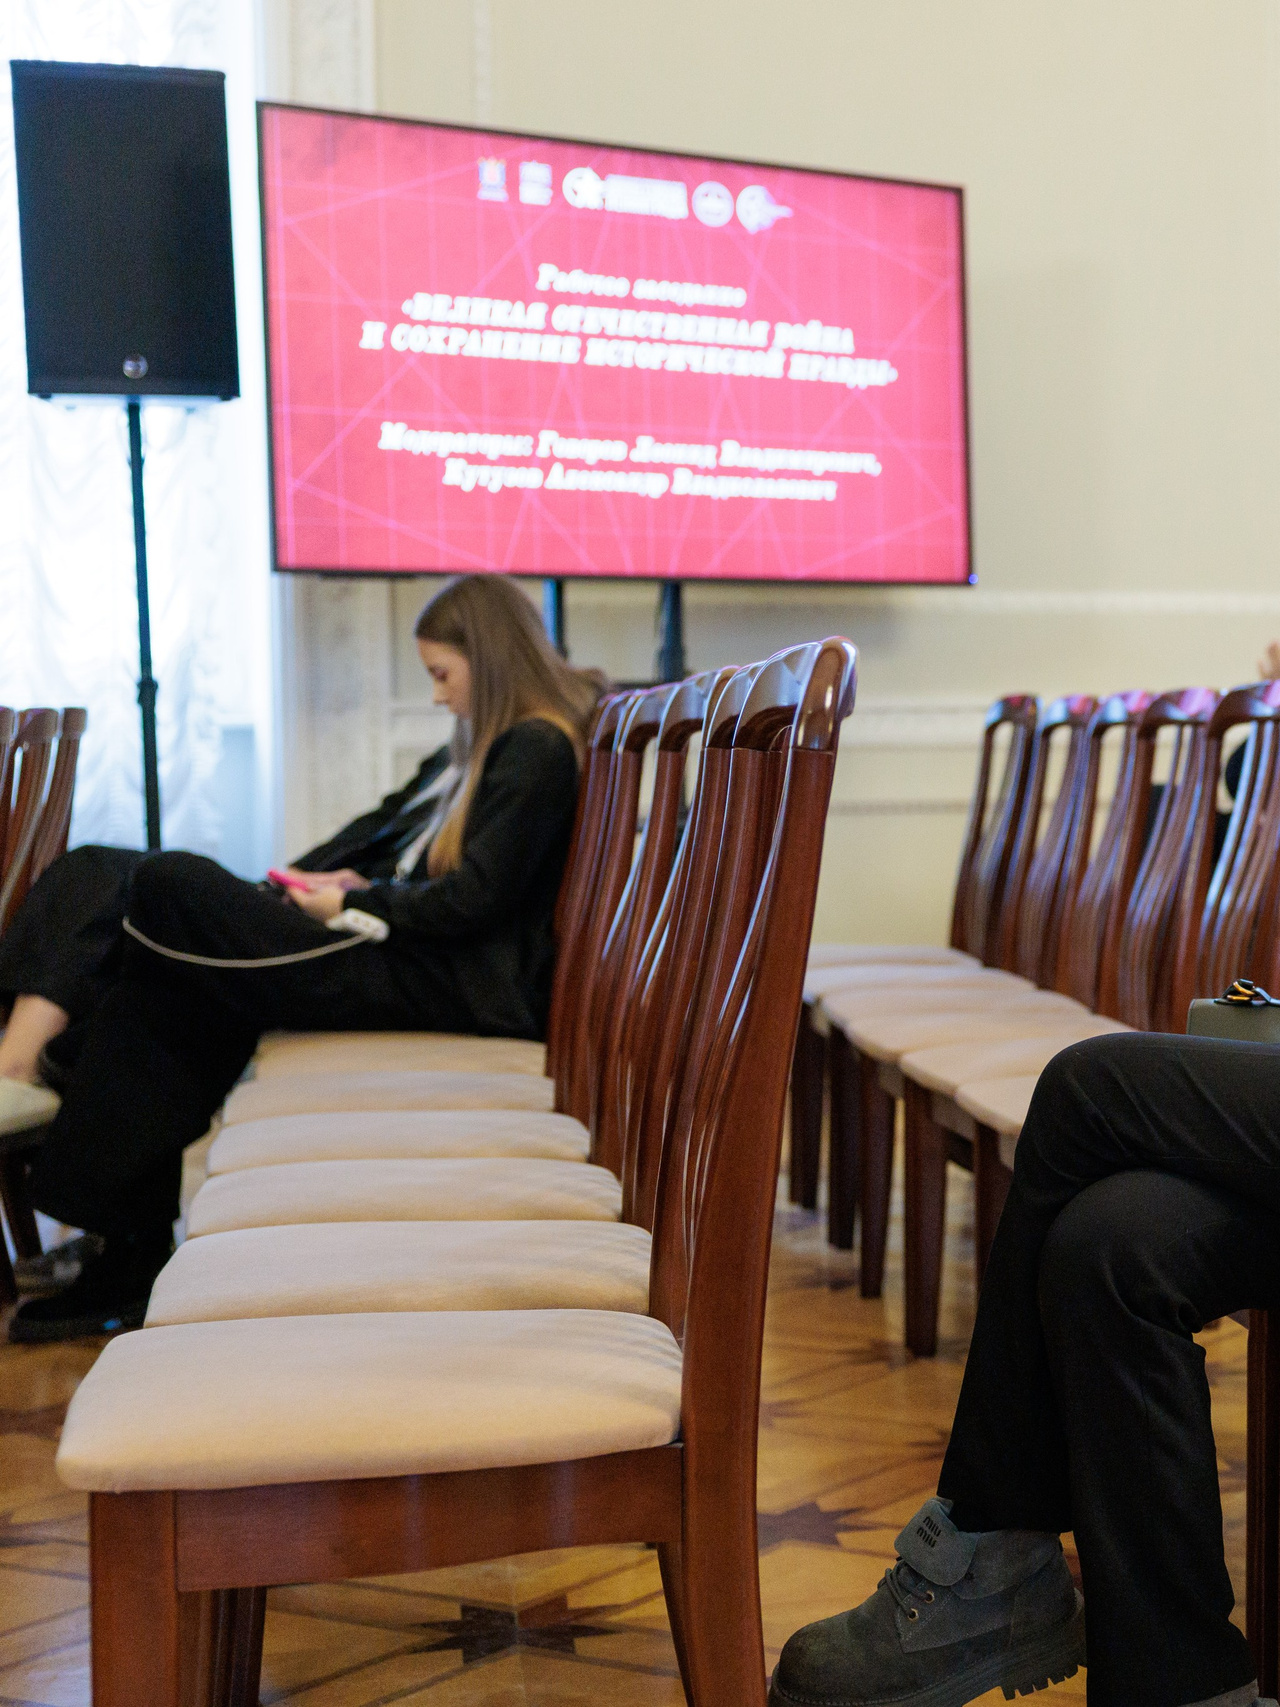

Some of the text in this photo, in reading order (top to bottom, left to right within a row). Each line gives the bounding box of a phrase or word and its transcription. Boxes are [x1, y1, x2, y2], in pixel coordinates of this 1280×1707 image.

[359, 321, 387, 350] И
[391, 323, 581, 364] СОХРАНЕНИЕ
[916, 1526, 937, 1548] miu
[923, 1516, 941, 1537] miu
